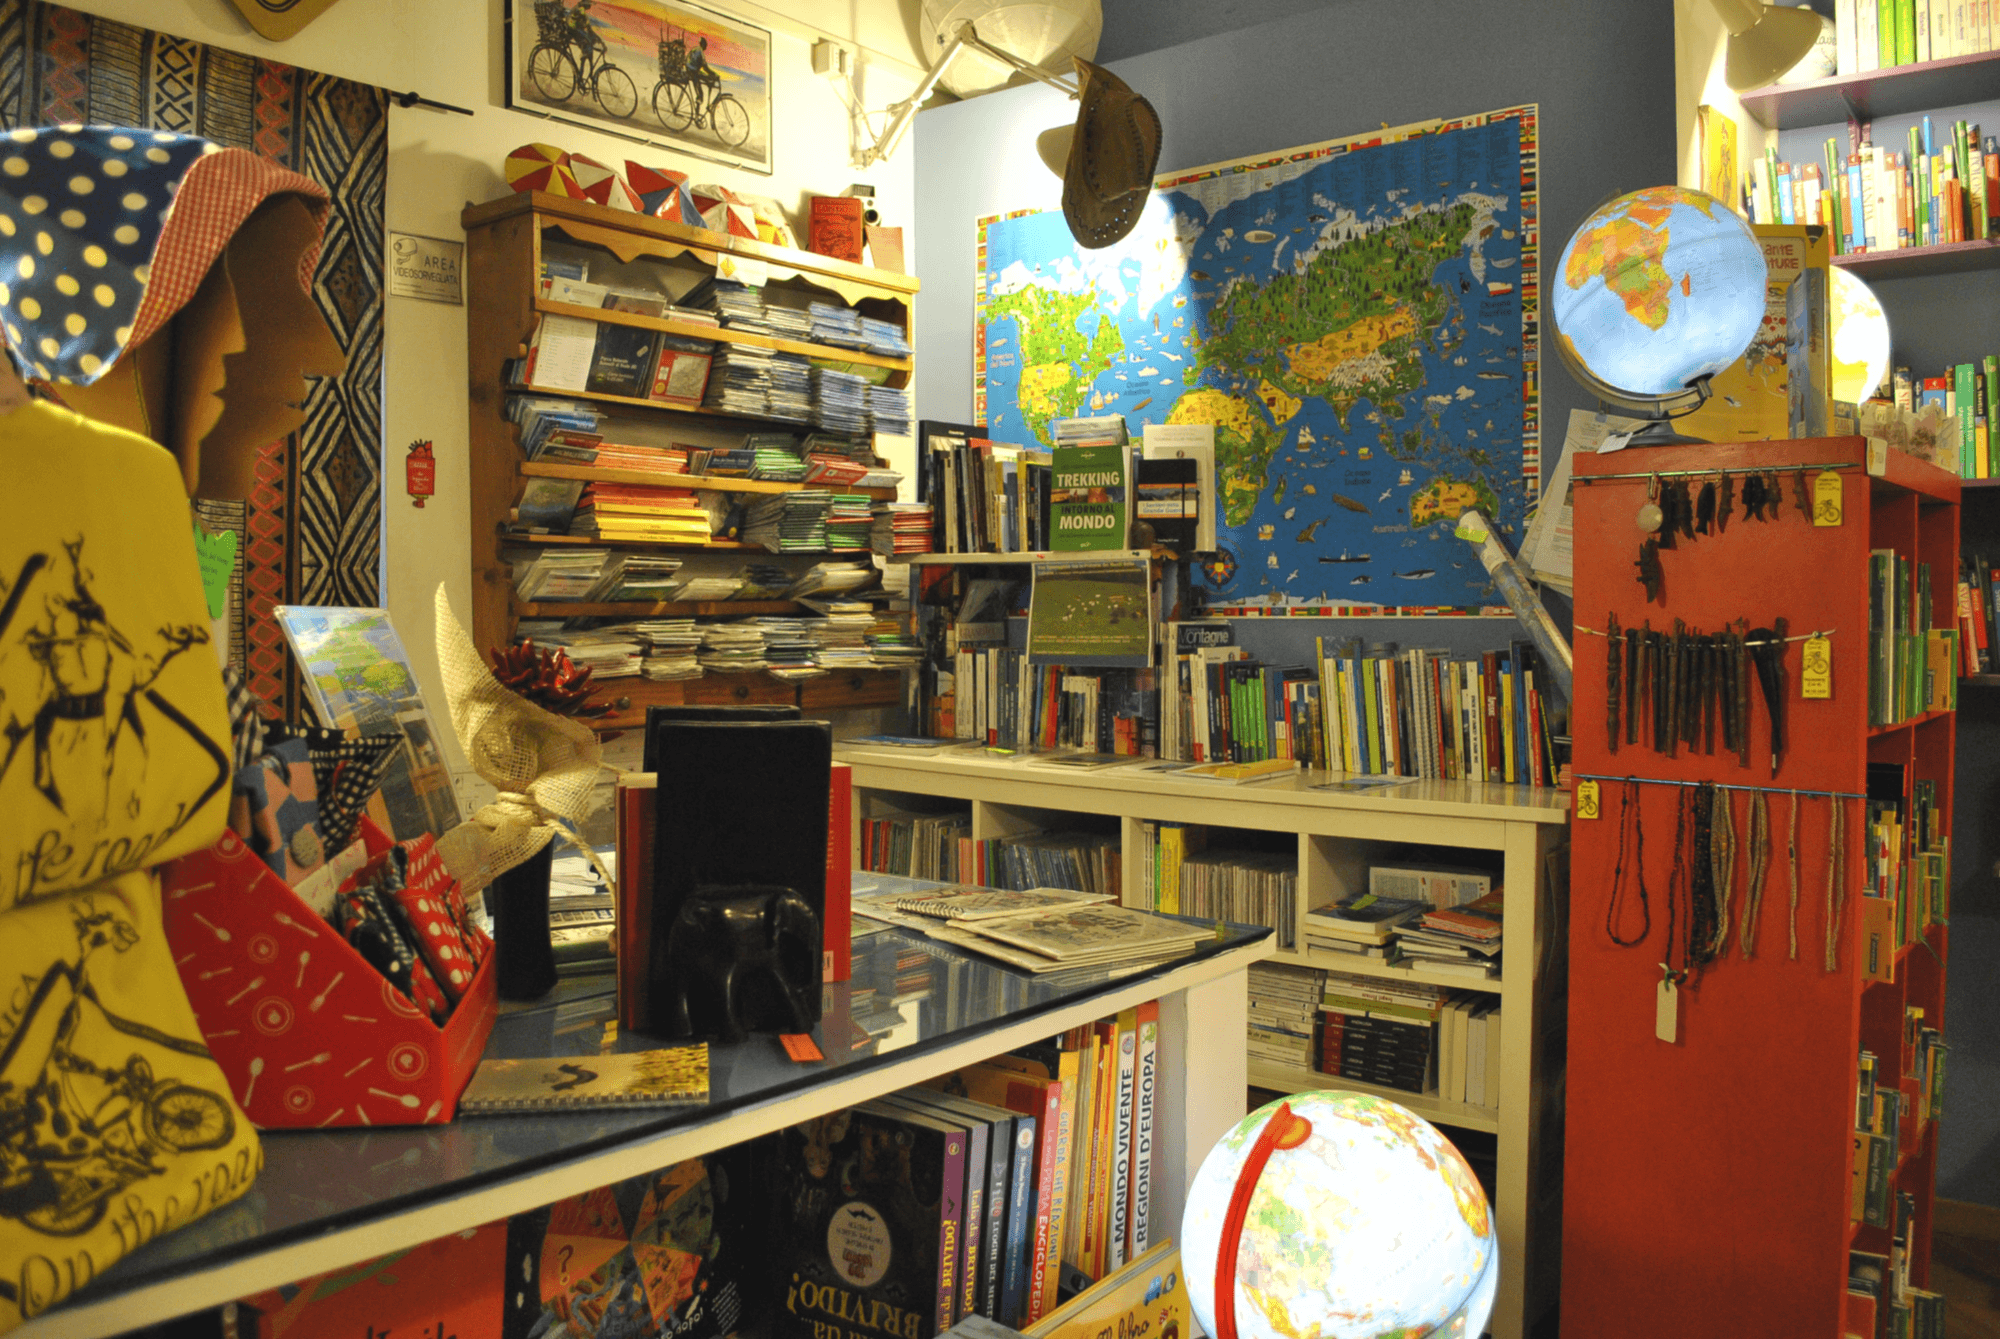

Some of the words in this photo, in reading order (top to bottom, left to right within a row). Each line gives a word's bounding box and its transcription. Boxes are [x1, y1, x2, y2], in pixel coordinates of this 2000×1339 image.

[1861, 167, 1873, 222] OLANDA
[1969, 155, 1981, 209] POLONIA
[424, 255, 455, 271] AREA
[1766, 244, 1793, 255] antE
[1768, 258, 1799, 269] tURE
[393, 266, 458, 284] VIDEOSORVEGLIATA
[1056, 471, 1120, 488] TREKKING
[1059, 515, 1115, 530] MONDO
[1061, 504, 1103, 514] INTORNO
[1105, 504, 1114, 513] AL
[1372, 524, 1408, 533] Australia
[1178, 627, 1228, 647] Montagne
[1117, 1069, 1132, 1158] VIVENTE
[1139, 1051, 1155, 1154] D'EUROPA
[1046, 1129, 1054, 1143] La
[1056, 1112, 1069, 1165] GUARDA
[1871, 1143, 1880, 1167] Touring
[1039, 1167, 1052, 1211] PRIMA
[1054, 1170, 1065, 1193] CHE
[1869, 1169, 1879, 1192] Editore
[970, 1189, 981, 1219] Italia
[1114, 1163, 1127, 1243] MONDO
[1136, 1160, 1150, 1243] REGIONI
[19, 1250, 94, 1321] On
[110, 1193, 180, 1252] the
[188, 1142, 264, 1218] roa
[969, 1222, 978, 1237] da
[990, 1221, 999, 1261] LUOGHI
[1047, 1198, 1063, 1269] REAZIONE!
[941, 1219, 957, 1287] BRIVIDO!
[963, 1245, 976, 1312] BRIVIDO!
[988, 1263, 997, 1283] DEL
[1031, 1215, 1049, 1324] ENCICLOPEDIA
[786, 1273, 922, 1339] BRIVIDO!
[940, 1295, 951, 1310] da
[986, 1285, 995, 1320] MISTE
[676, 1307, 703, 1334] dopo!
